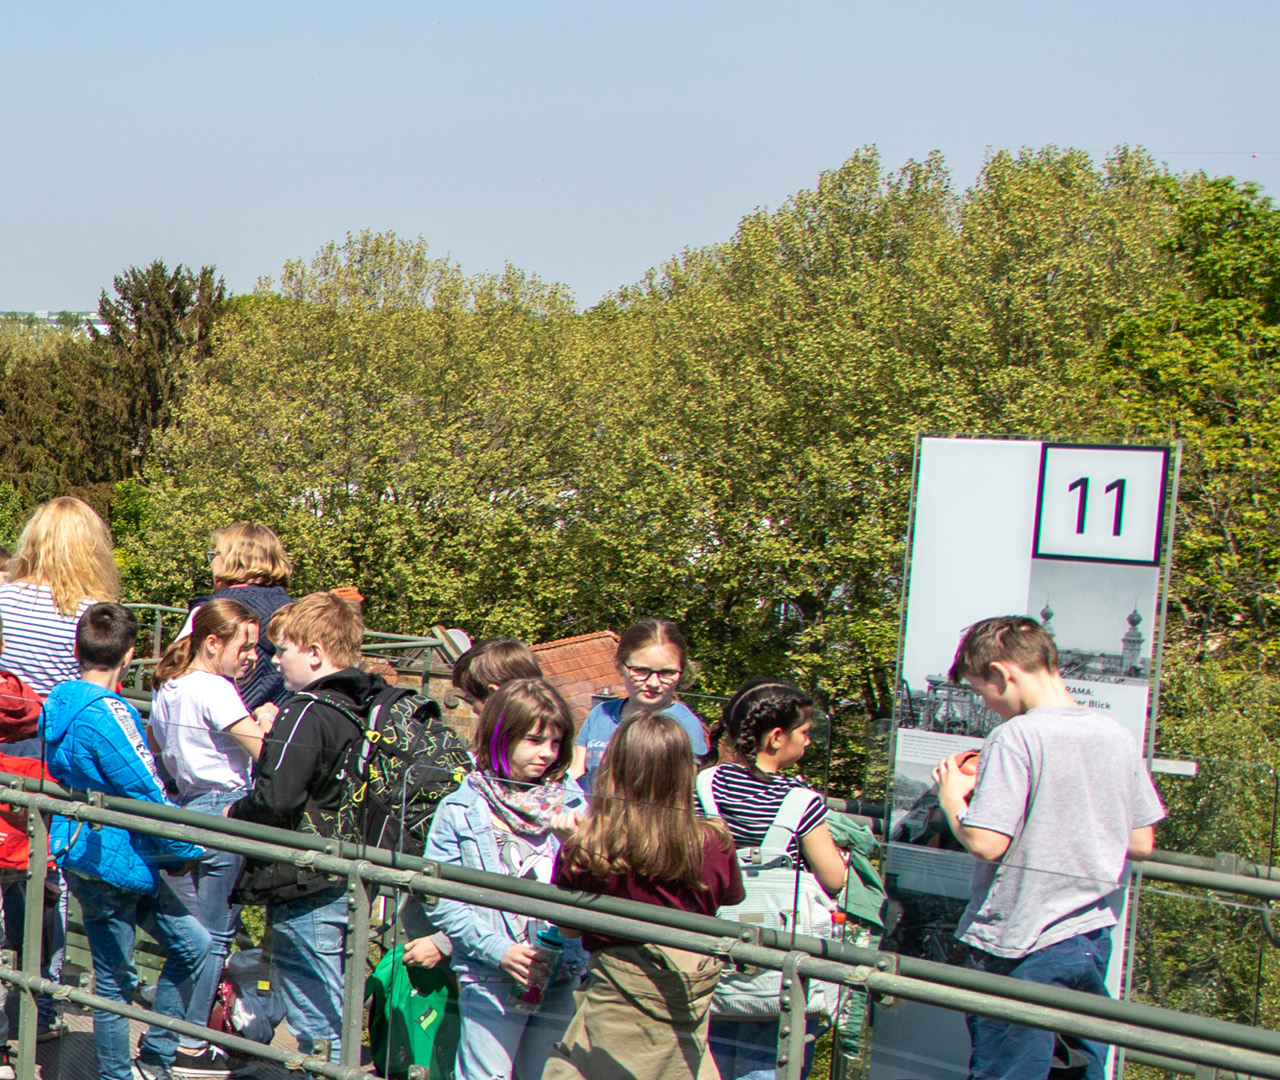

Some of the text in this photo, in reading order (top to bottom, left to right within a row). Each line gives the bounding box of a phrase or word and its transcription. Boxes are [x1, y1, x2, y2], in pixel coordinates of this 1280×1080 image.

[1068, 477, 1127, 537] 11
[1065, 685, 1095, 697] RAMA:
[1088, 700, 1111, 710] Blick
